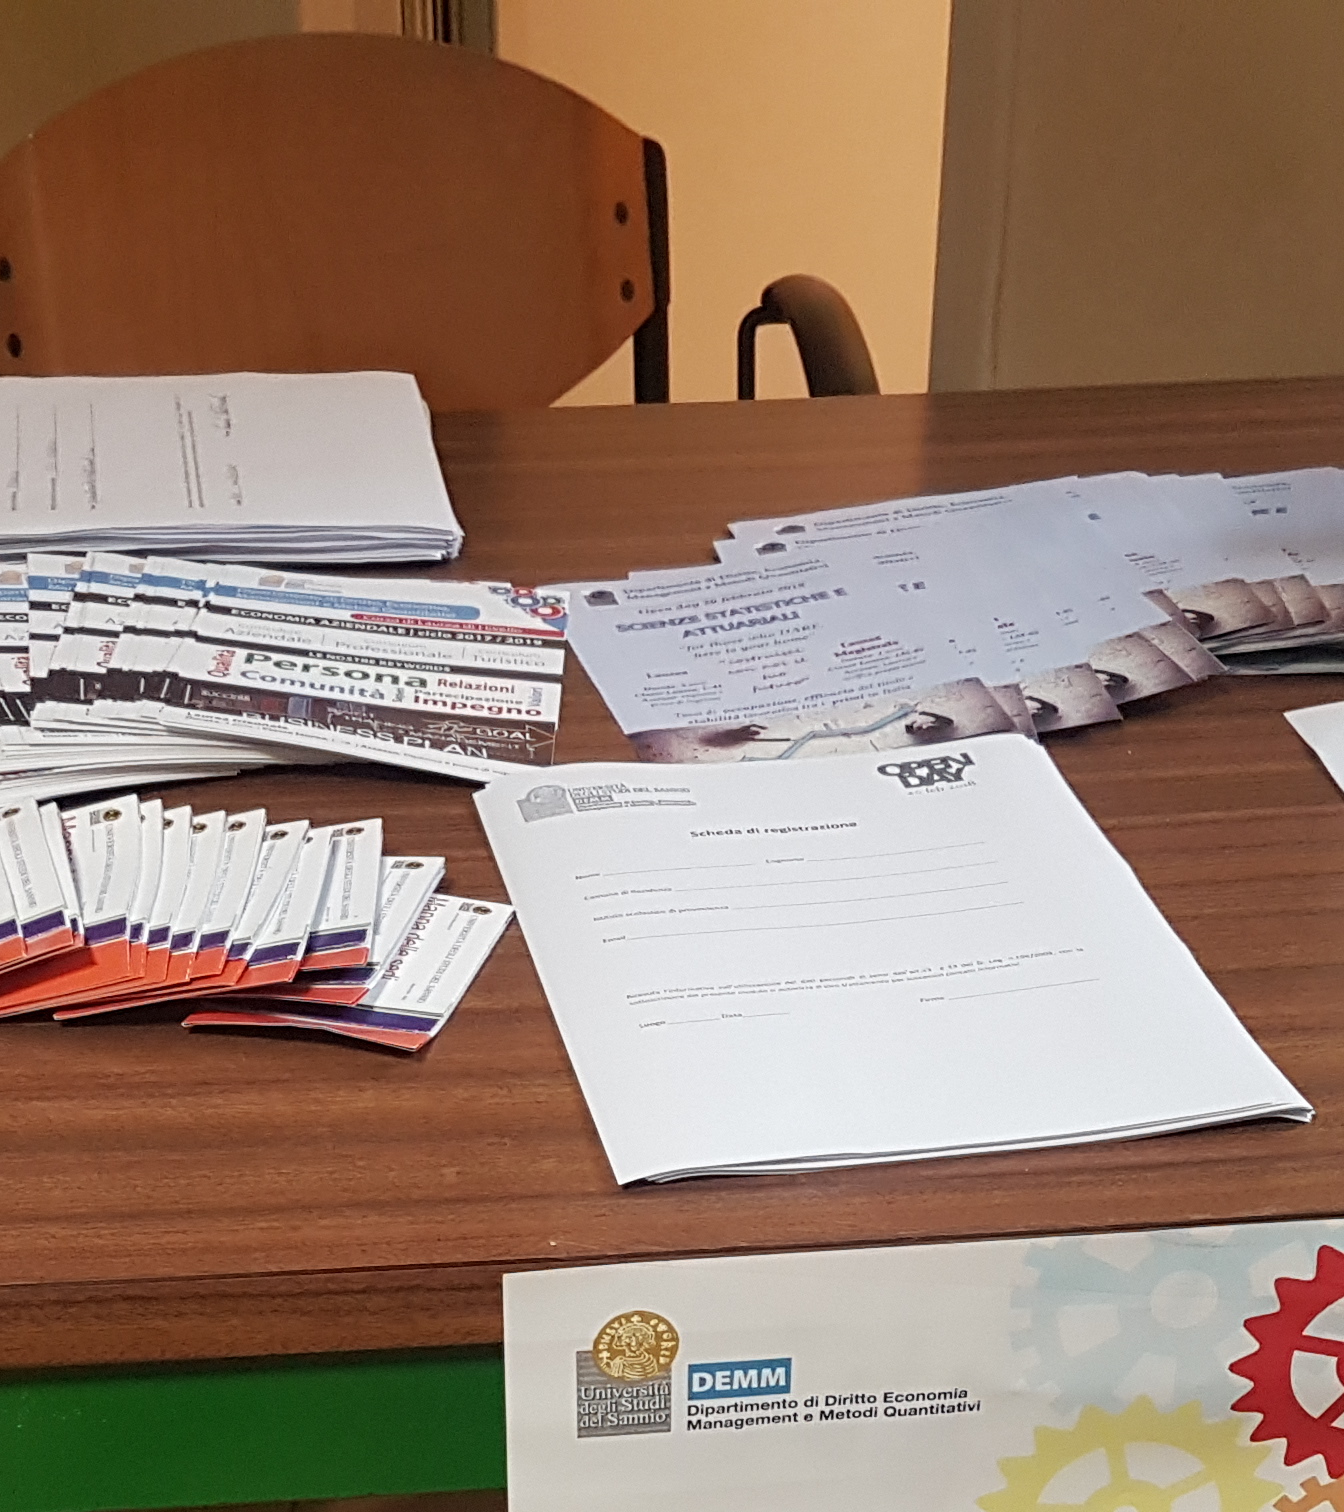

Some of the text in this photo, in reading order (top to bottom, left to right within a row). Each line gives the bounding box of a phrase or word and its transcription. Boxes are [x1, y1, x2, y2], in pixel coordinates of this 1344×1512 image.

[615, 587, 849, 632] SCIENZE STATISTICHE E
[223, 626, 312, 646] Aziendale
[231, 608, 543, 646] ECONOMIA AZIENDALE ciclo 2017 2019
[682, 611, 801, 639] ATTUARIALI
[333, 640, 454, 660] Professionale
[471, 653, 546, 668] Turistico
[207, 650, 236, 678] Qualità
[243, 651, 429, 689] Persona
[377, 658, 452, 673] KEYWORDS
[239, 669, 386, 701] Comunità
[437, 677, 516, 695] Relazioni
[414, 688, 524, 706] Partecipazione
[414, 695, 542, 717] Impegno
[241, 711, 394, 743] BUSINESS
[402, 736, 490, 760] PLAN
[876, 751, 977, 777] OPEN
[898, 767, 965, 789] DAY
[689, 820, 858, 838] Scheda di registrazione
[691, 1367, 787, 1393] DEMM
[580, 1382, 670, 1401] Università
[580, 1397, 666, 1416] degli Studi
[687, 1387, 969, 1419] Dipartimento di Diritto Economia
[580, 1409, 669, 1428] del Sannio
[687, 1399, 982, 1432] Management e Metodi Quantitativi
